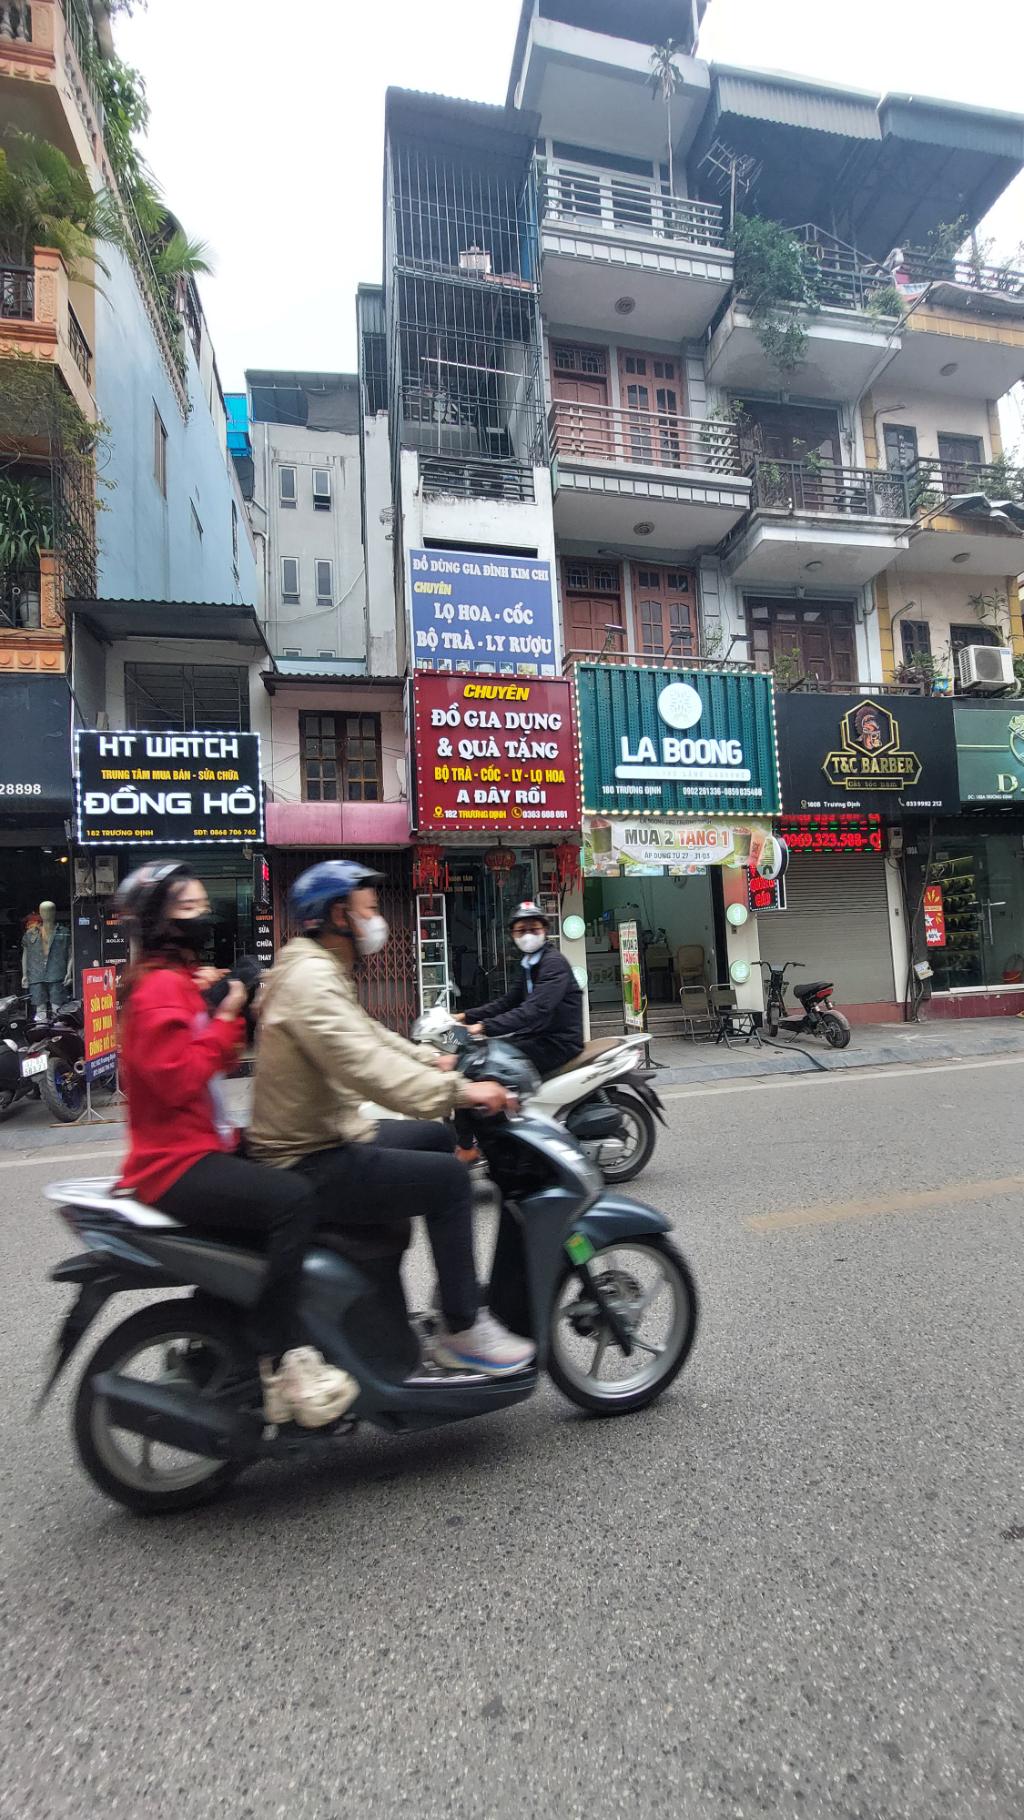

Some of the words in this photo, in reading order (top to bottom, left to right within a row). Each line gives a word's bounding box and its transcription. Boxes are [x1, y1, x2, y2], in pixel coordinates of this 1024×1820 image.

[413, 555, 428, 571] ĐỒ
[431, 558, 460, 574] DÙNG
[463, 563, 481, 576] GIA
[483, 562, 508, 578] ĐÌNH
[511, 567, 530, 580] KIM
[531, 569, 549, 581] CHI
[414, 581, 452, 595] CHUYÊN
[434, 602, 455, 623] LỌ
[458, 604, 492, 622] HOA
[503, 602, 533, 625] CỐC
[416, 627, 439, 652] BỘ
[442, 629, 475, 650] TRÀ
[486, 635, 505, 652] LY
[509, 635, 552, 658] RƯỢU
[463, 684, 530, 701] CHUYÊN
[431, 702, 461, 727] ĐỒ
[464, 709, 502, 729] GIA
[504, 712, 562, 735] DỤNG
[100, 737, 137, 757] HT
[146, 737, 239, 759] WATCH
[437, 737, 453, 757] &
[458, 736, 501, 760] QUÀ
[504, 737, 559, 762] TẶNG
[621, 736, 657, 763] LA
[662, 737, 743, 765] BOONG
[101, 769, 130, 780] TRUNG
[132, 768, 150, 780] TÂM
[152, 770, 171, 780] MUA
[173, 769, 190, 780] BÁN
[198, 768, 216, 781] SỬA
[217, 770, 239, 781] CHỮA
[434, 764, 450, 784] BỘ
[451, 766, 473, 782] TRÀ
[480, 764, 500, 783] CỐC
[511, 769, 523, 783] LY
[531, 769, 543, 785] LỌ
[545, 770, 566, 784] HOA
[831, 757, 857, 774] T&C
[861, 757, 915, 774] BARBER
[0, 784, 42, 795] 28898
[83, 785, 192, 815] ĐỒNG
[203, 785, 256, 815] HỒ
[457, 789, 470, 803] A
[474, 787, 511, 804] ĐÂY
[515, 786, 546, 804] RỒI
[87, 829, 99, 837] 182
[624, 829, 660, 846] MUA
[664, 830, 674, 846] 2
[721, 830, 729, 847] 1
